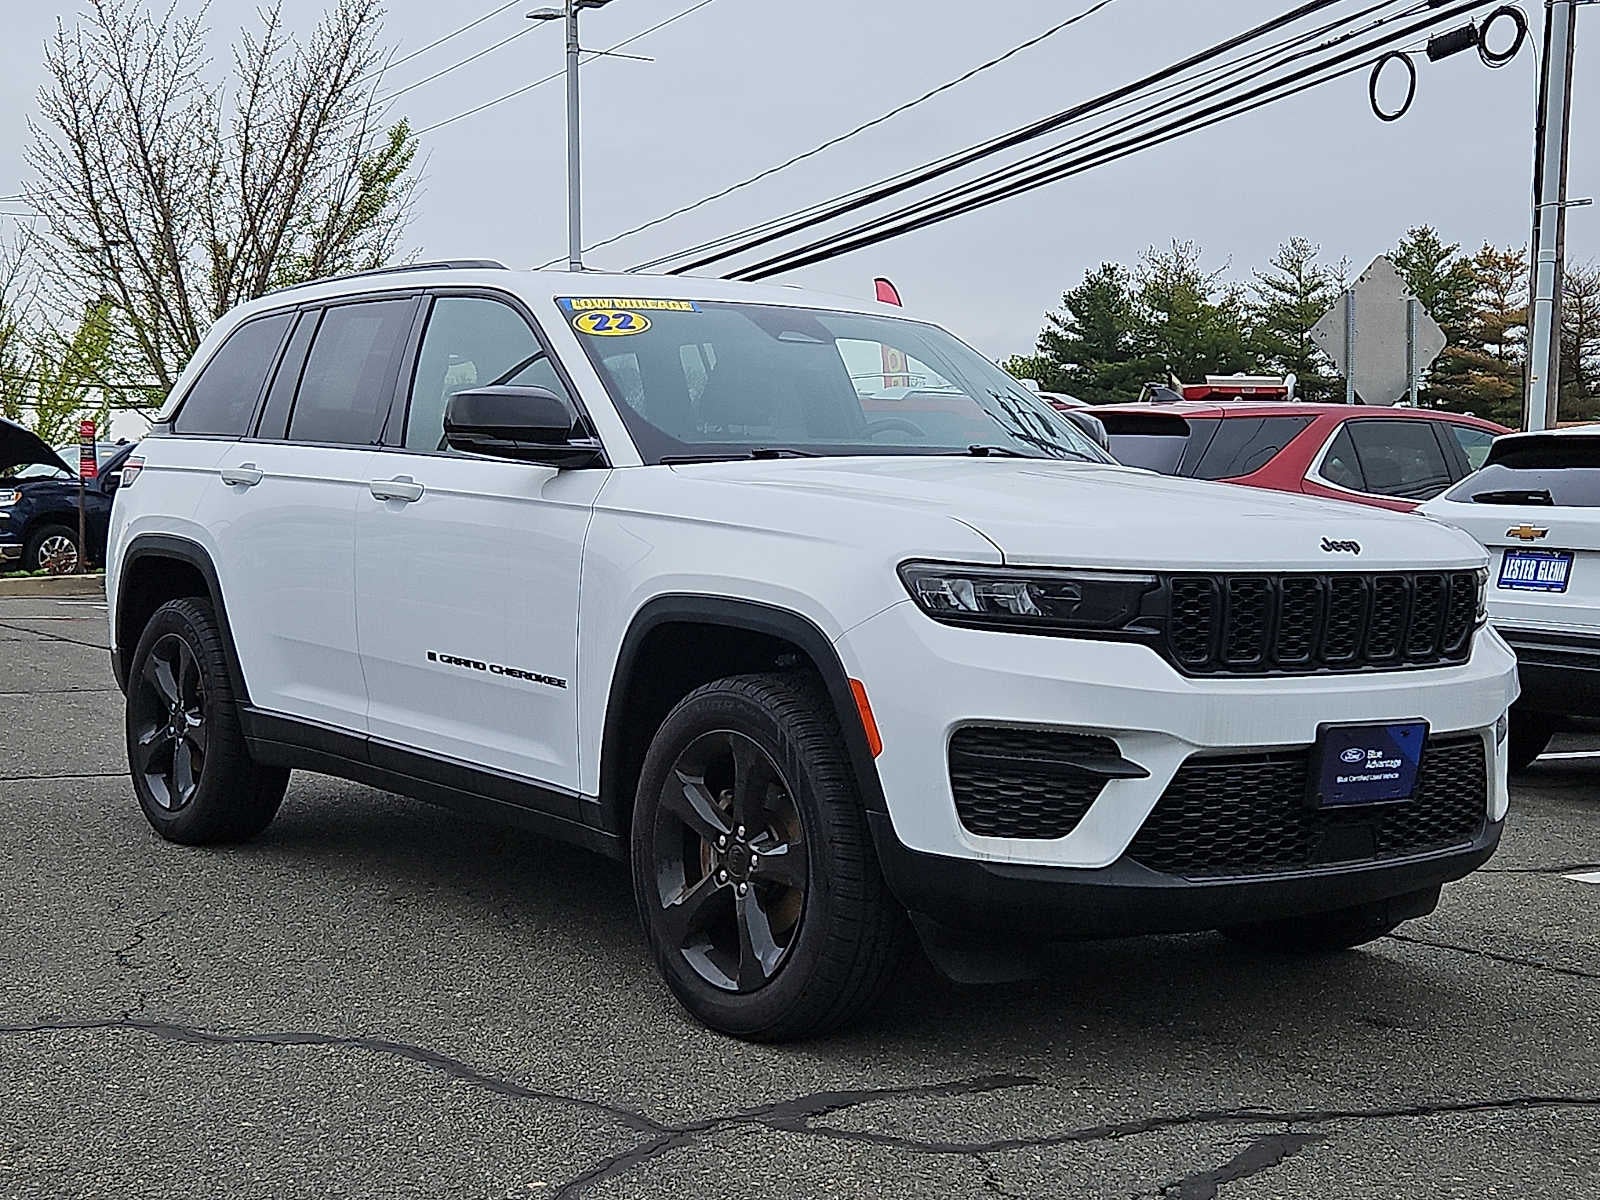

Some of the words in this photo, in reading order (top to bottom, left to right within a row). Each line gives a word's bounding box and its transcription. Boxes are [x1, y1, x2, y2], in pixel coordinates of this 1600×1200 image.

[571, 299, 612, 310] LOW
[613, 301, 694, 311] MILEAGE
[588, 313, 636, 331] 22
[1320, 537, 1361, 555] Jeep
[1502, 559, 1537, 580] LESTER
[1537, 560, 1567, 582] GLENN
[439, 654, 487, 671] GRAND
[489, 664, 567, 689] CHEROKEE
[1367, 749, 1383, 759] Blue
[1365, 759, 1401, 769] Advantage
